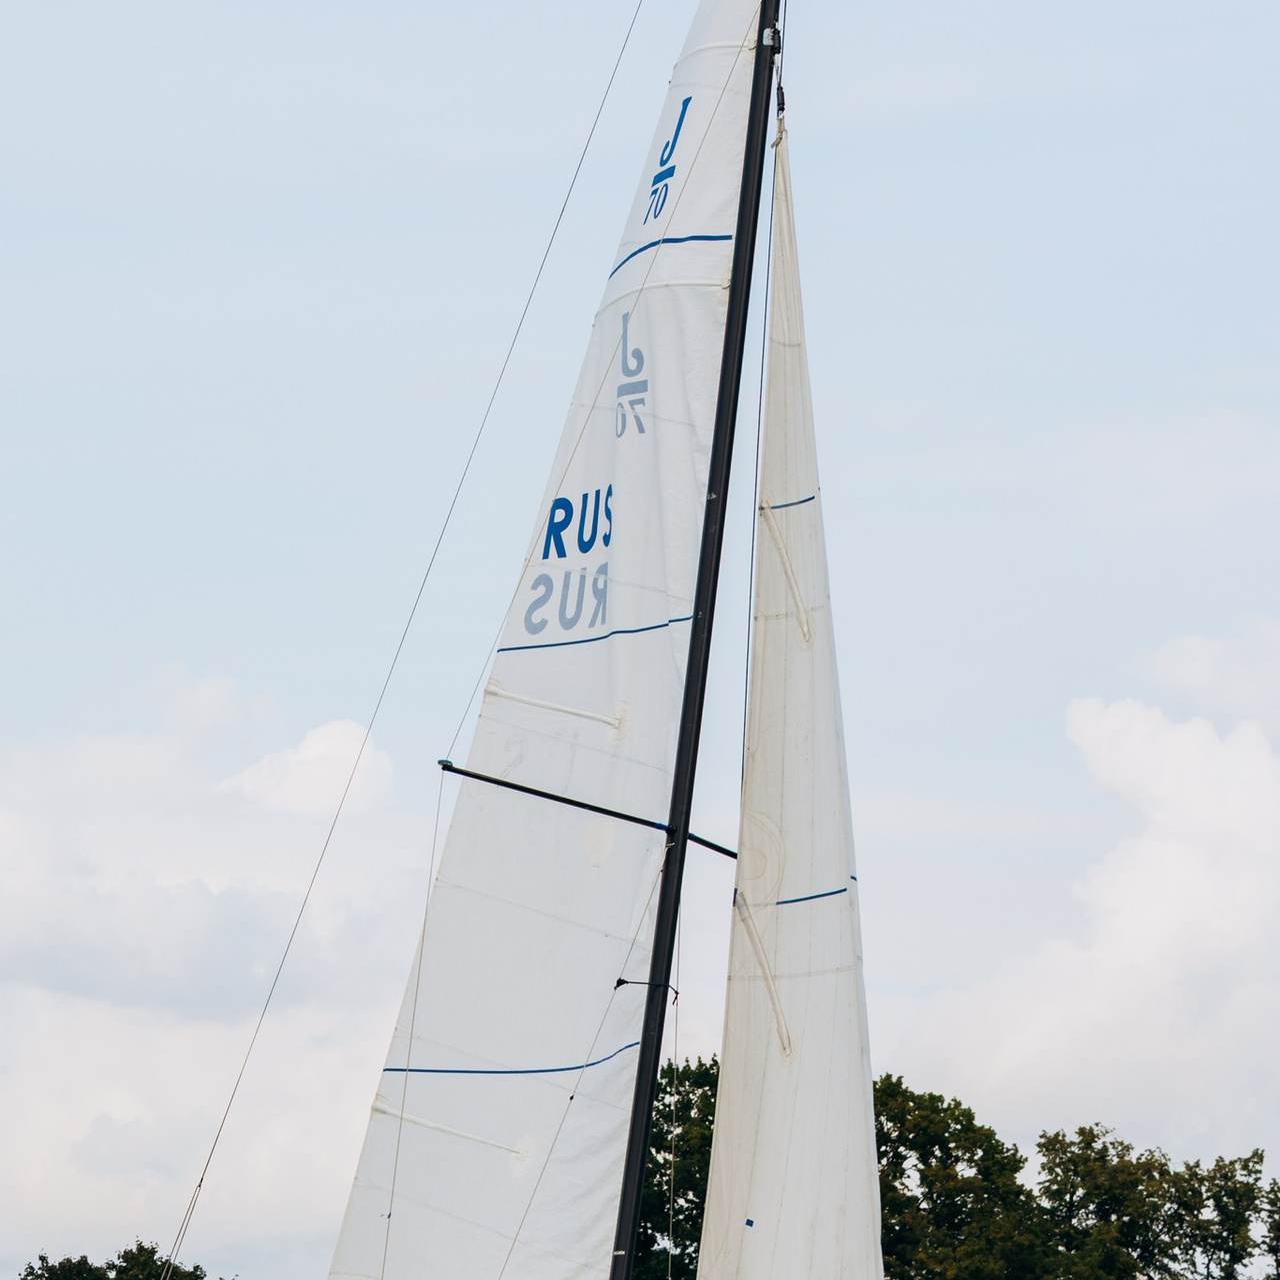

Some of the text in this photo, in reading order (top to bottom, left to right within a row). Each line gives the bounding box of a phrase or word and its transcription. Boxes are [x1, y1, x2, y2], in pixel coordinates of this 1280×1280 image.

[659, 96, 692, 167] J
[642, 183, 668, 225] 70
[542, 484, 612, 560] RUS
